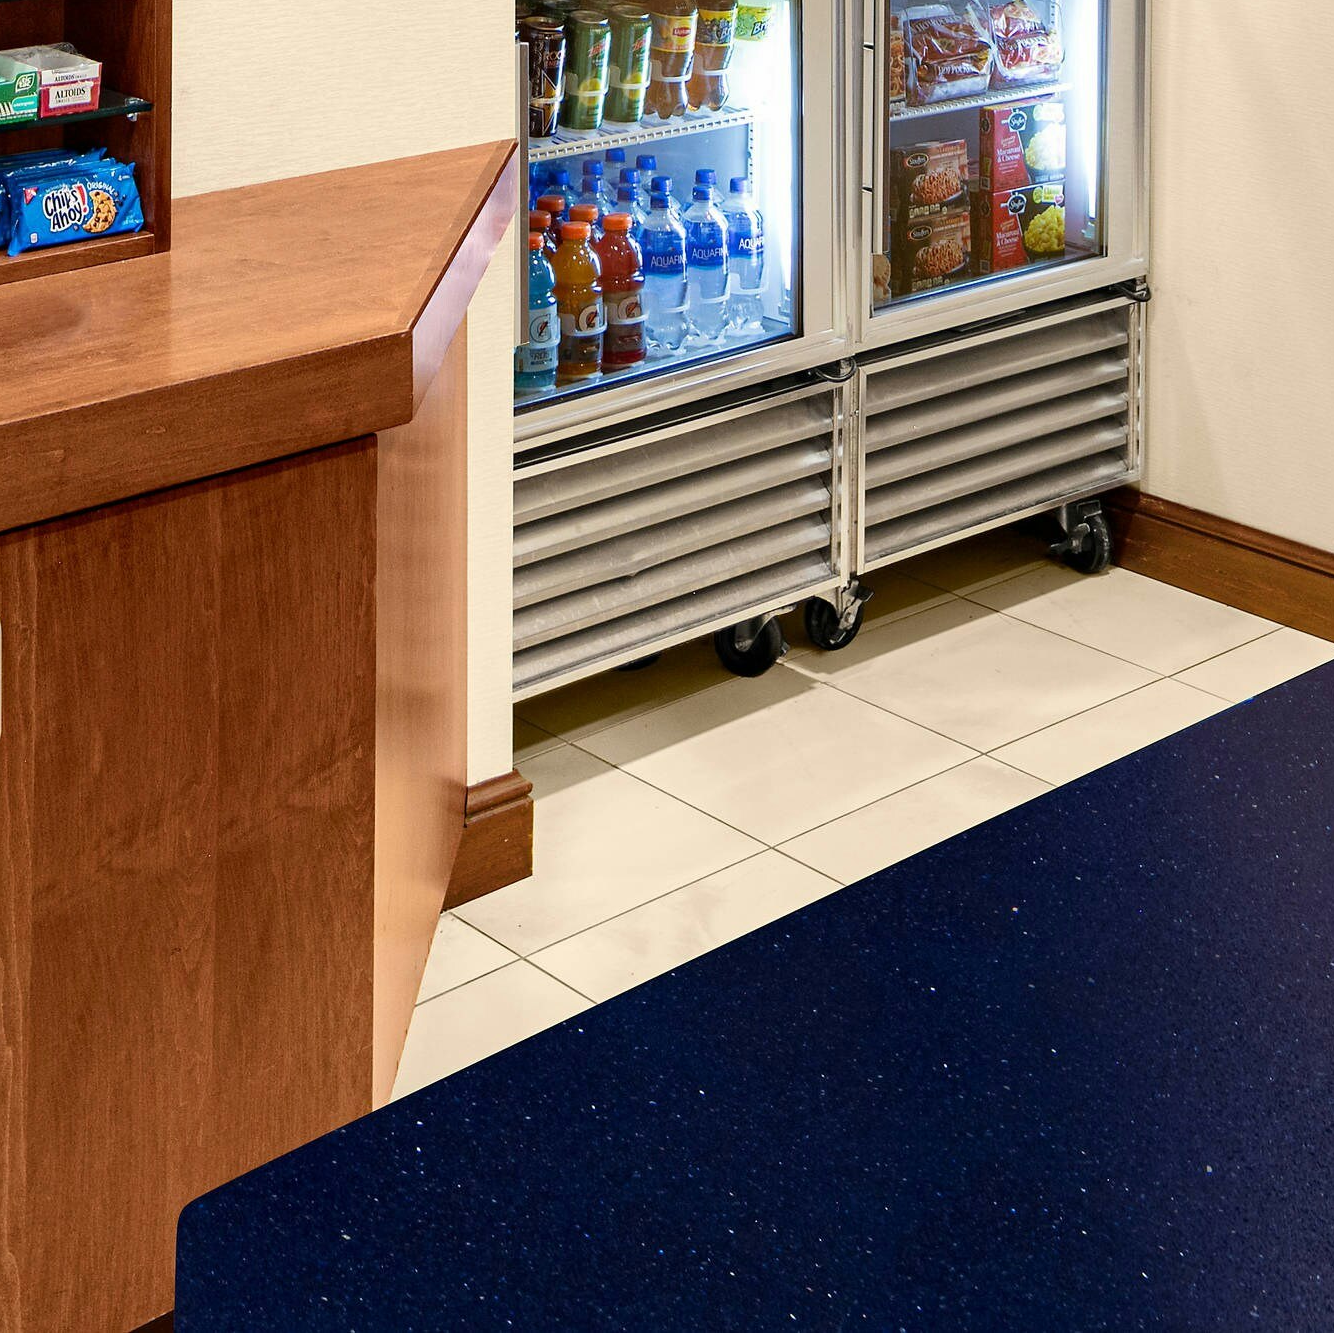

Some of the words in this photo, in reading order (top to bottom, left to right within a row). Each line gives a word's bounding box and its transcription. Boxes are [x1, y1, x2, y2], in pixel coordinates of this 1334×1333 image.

[54, 87, 86, 100] ALTOIDS
[44, 187, 79, 215] Chips
[692, 248, 729, 260] AQUAFIN
